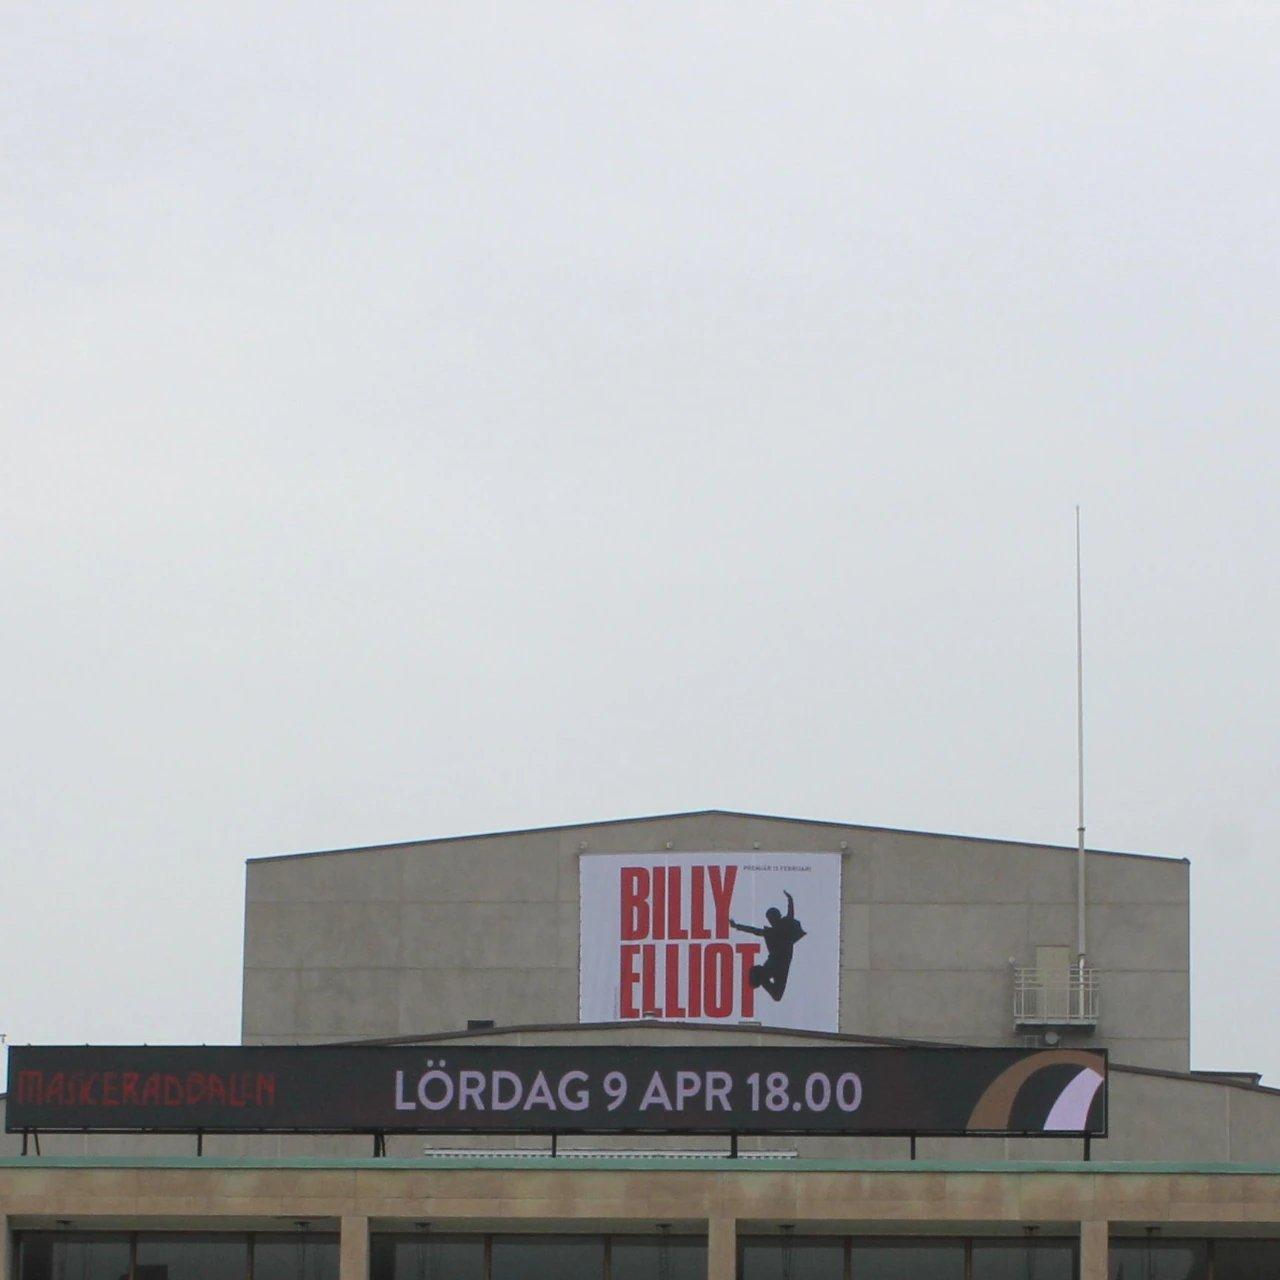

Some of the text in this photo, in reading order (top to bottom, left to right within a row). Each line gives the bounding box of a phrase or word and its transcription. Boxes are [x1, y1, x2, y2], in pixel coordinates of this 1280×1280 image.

[620, 865, 738, 941] BILLY
[620, 943, 761, 1019] ELLIOT
[395, 1059, 862, 1111] LÖRDAG 9 APR 18.00
